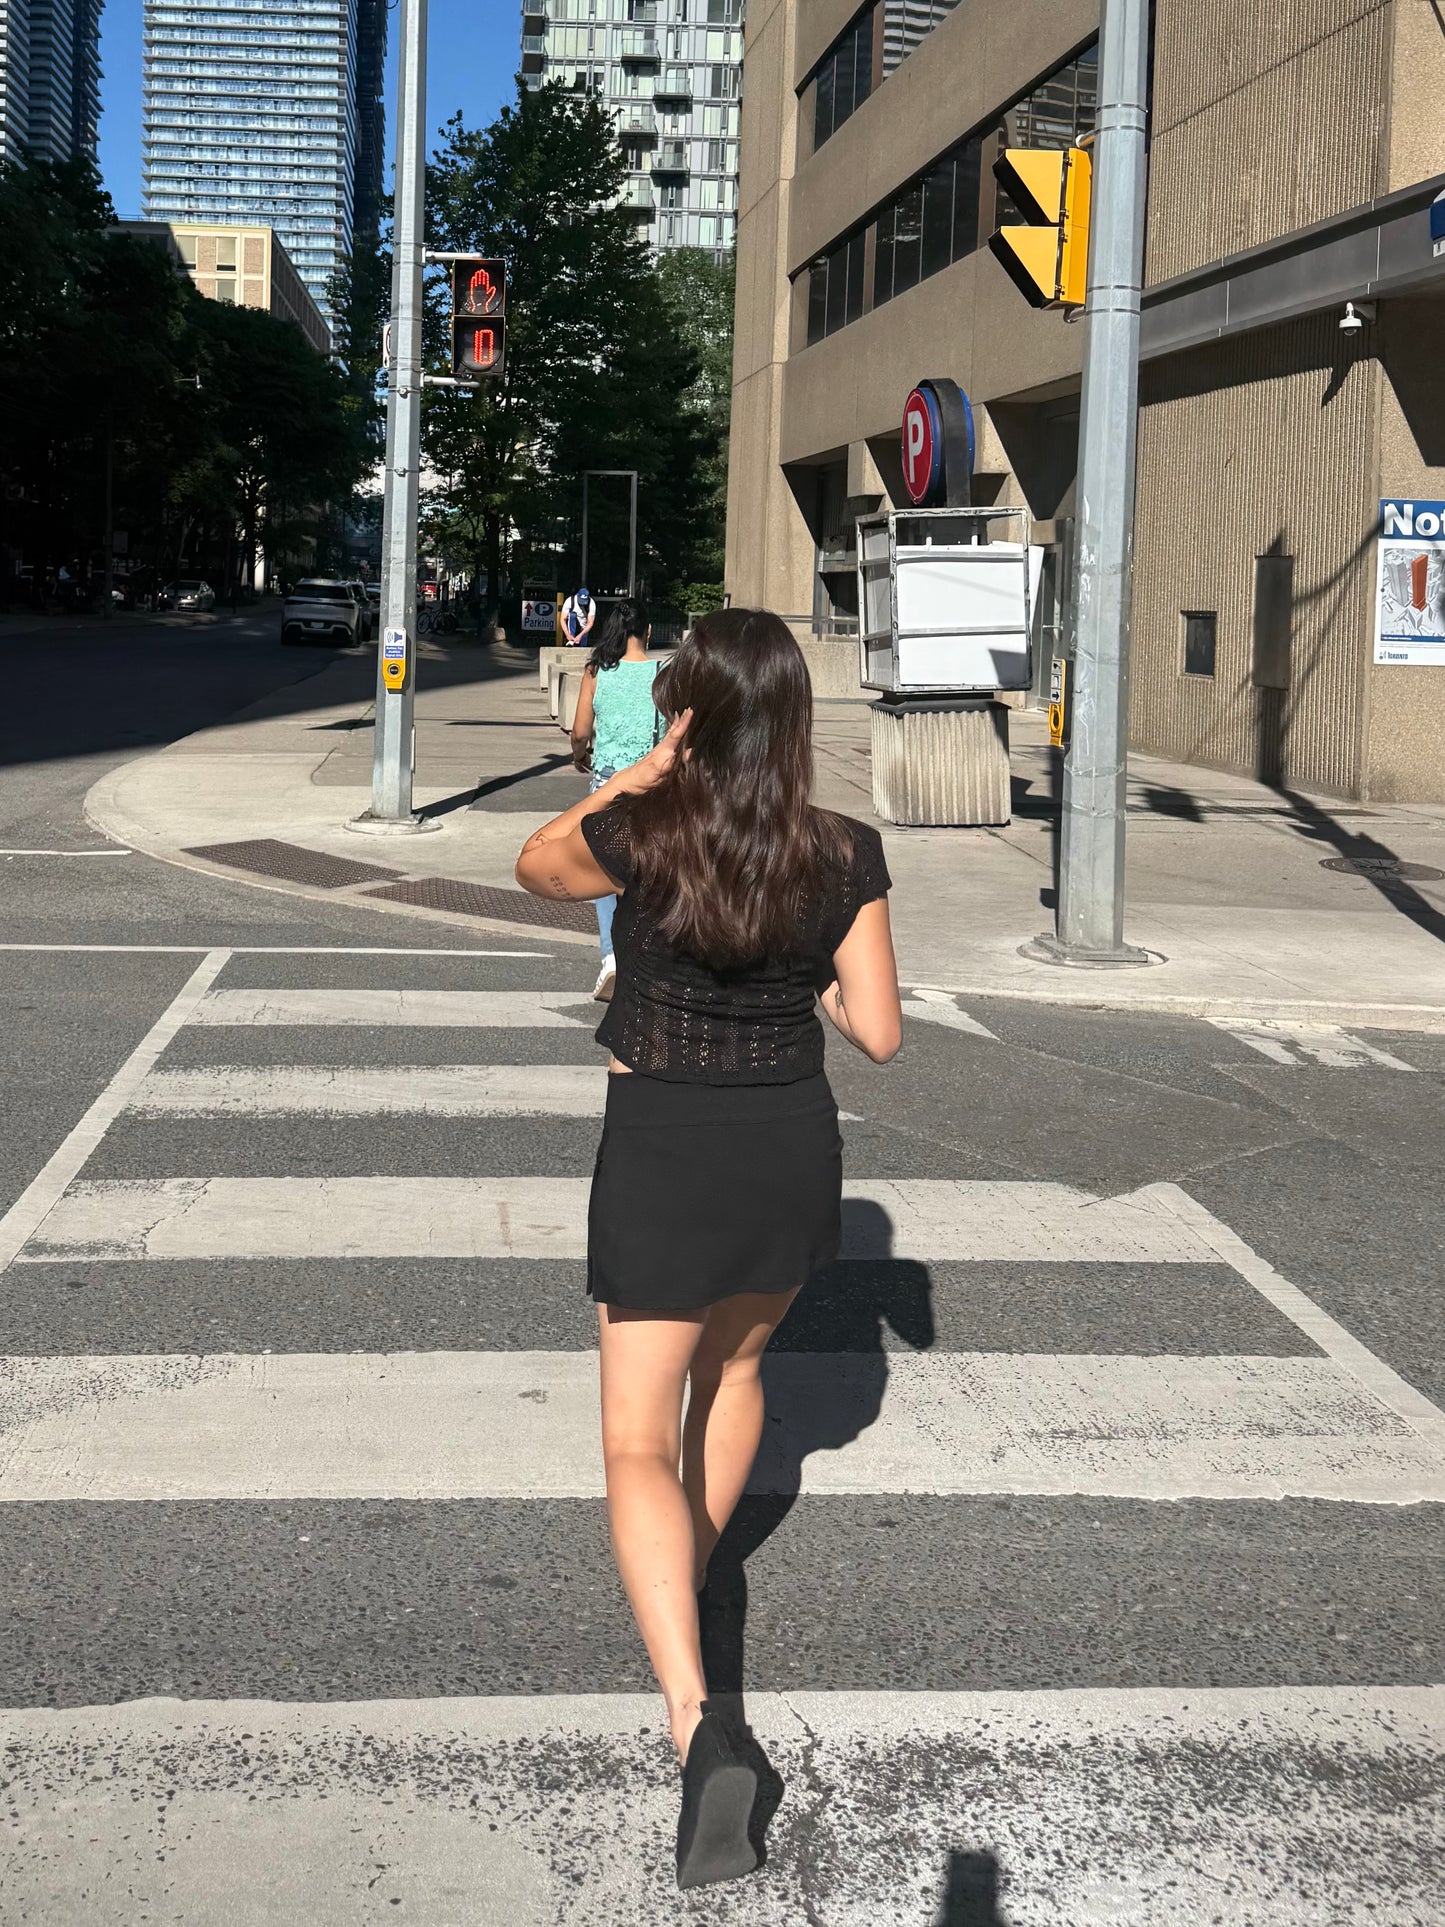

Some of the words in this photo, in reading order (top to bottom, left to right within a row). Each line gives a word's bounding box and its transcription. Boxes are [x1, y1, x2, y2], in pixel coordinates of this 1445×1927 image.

[474, 329, 494, 365] 10
[907, 410, 924, 483] P
[539, 604, 550, 615] P
[524, 617, 554, 630] Parking
